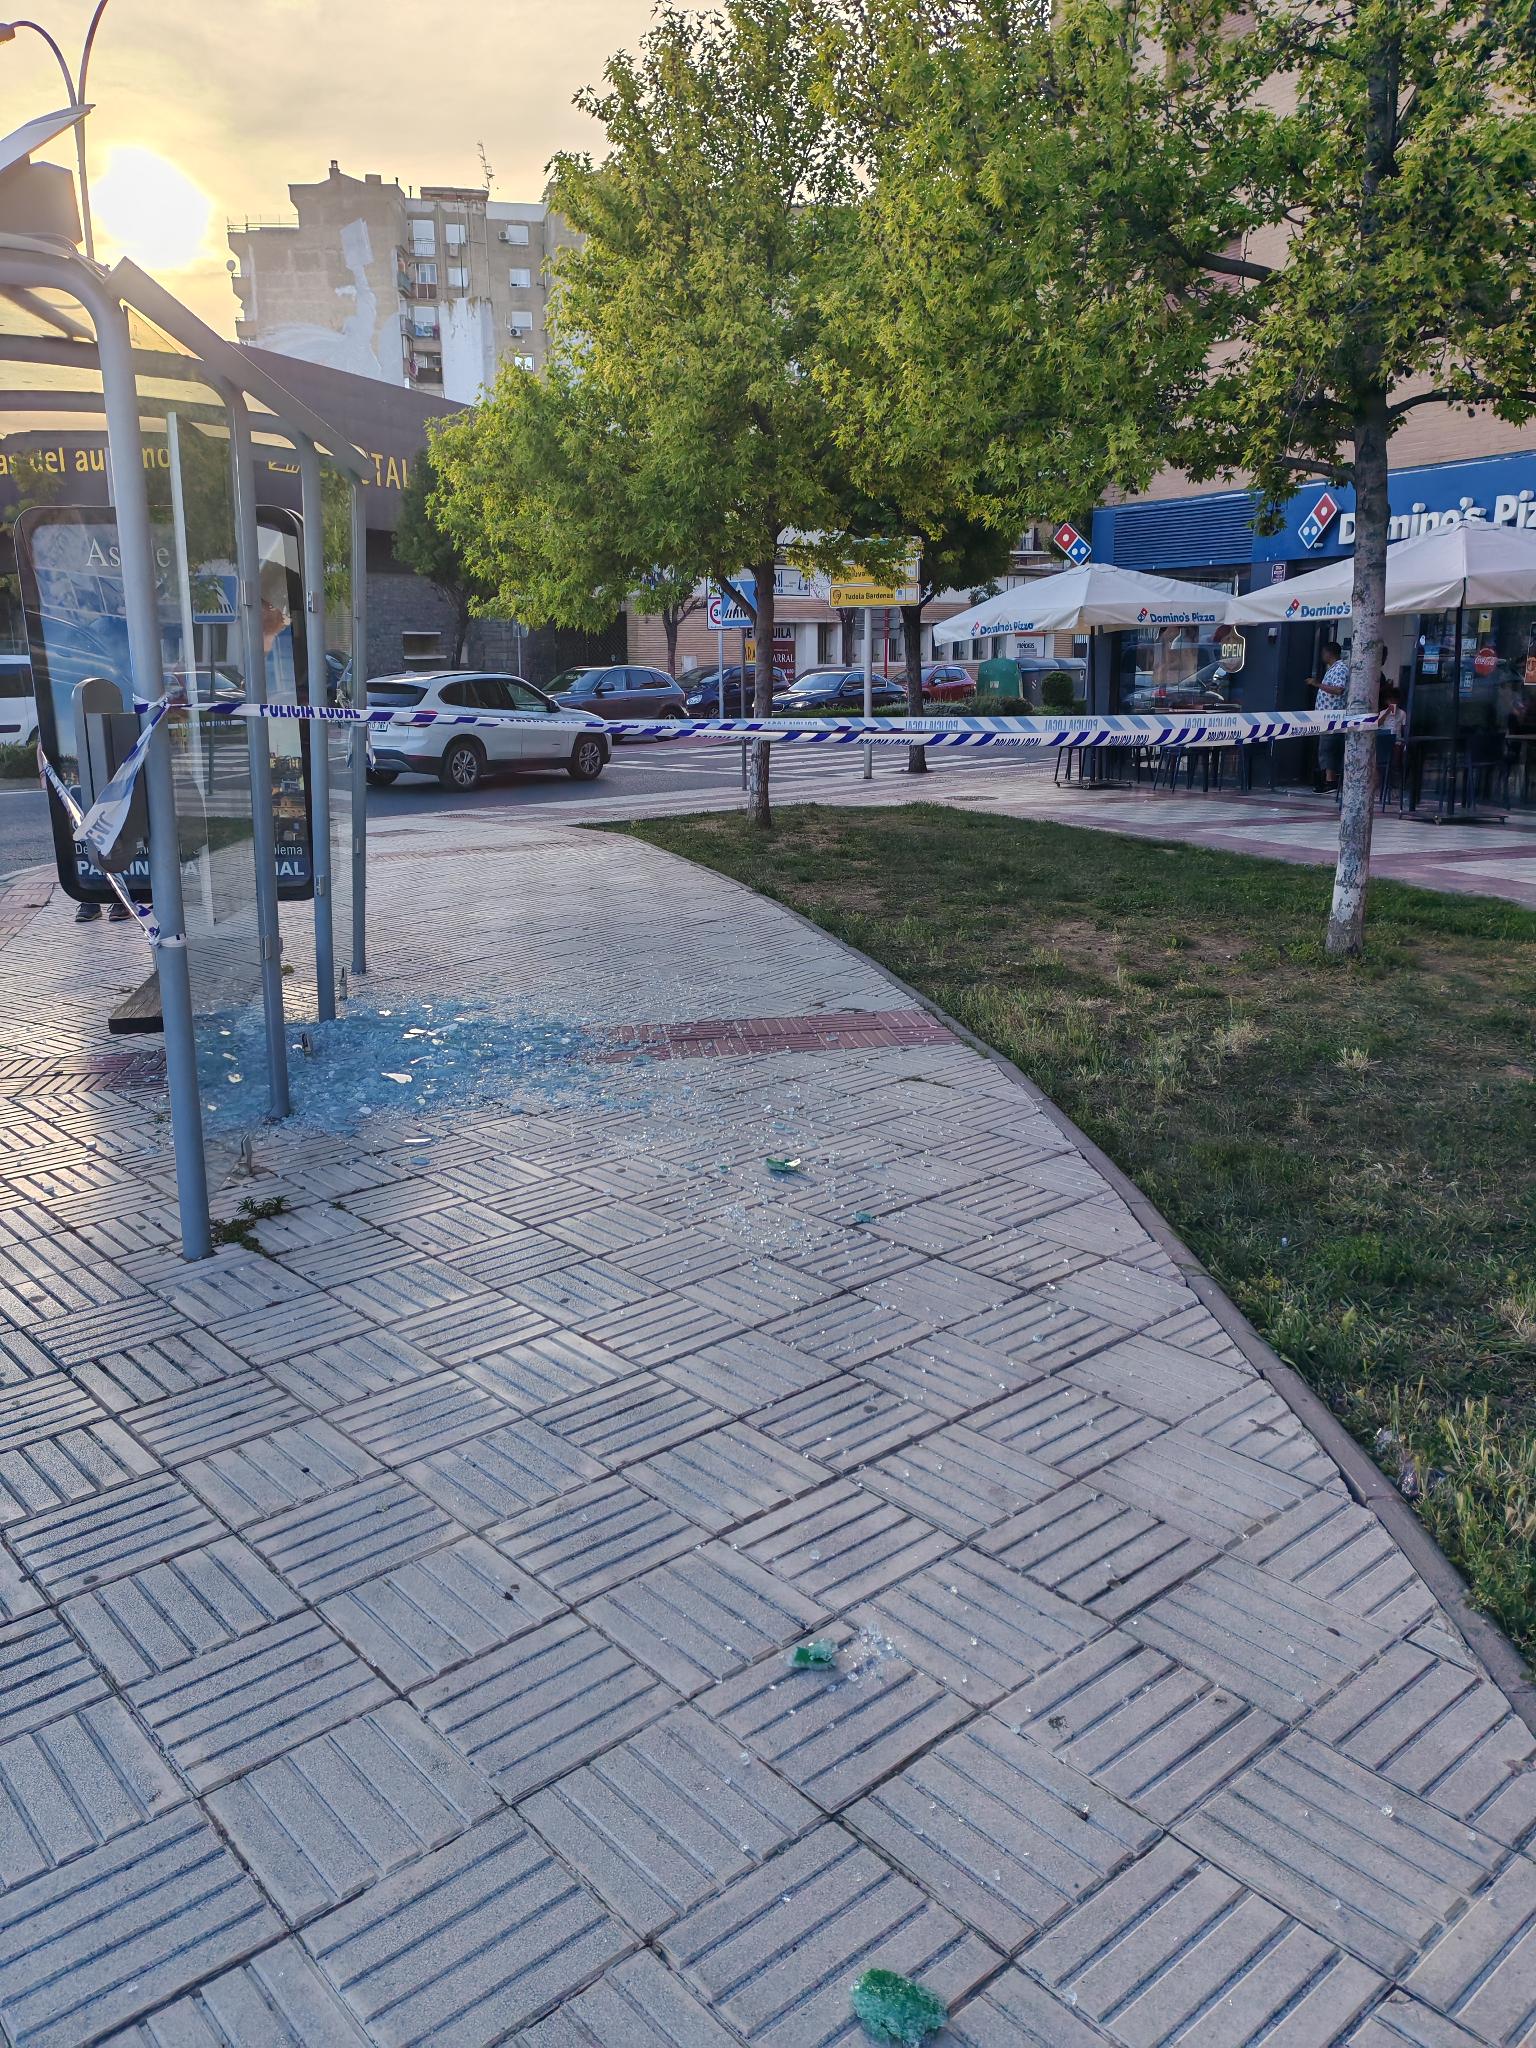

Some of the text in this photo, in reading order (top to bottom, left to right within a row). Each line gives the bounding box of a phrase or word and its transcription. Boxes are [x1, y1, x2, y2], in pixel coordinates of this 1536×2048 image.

[1338, 497, 1487, 545] Dmino's
[1150, 612, 1216, 623] Domino's Pizza
[1300, 603, 1351, 618] Domino's
[980, 621, 1034, 635] Domino's Pizza
[1221, 643, 1243, 657] OPEN
[260, 704, 360, 719] POLICIA LOCAL
